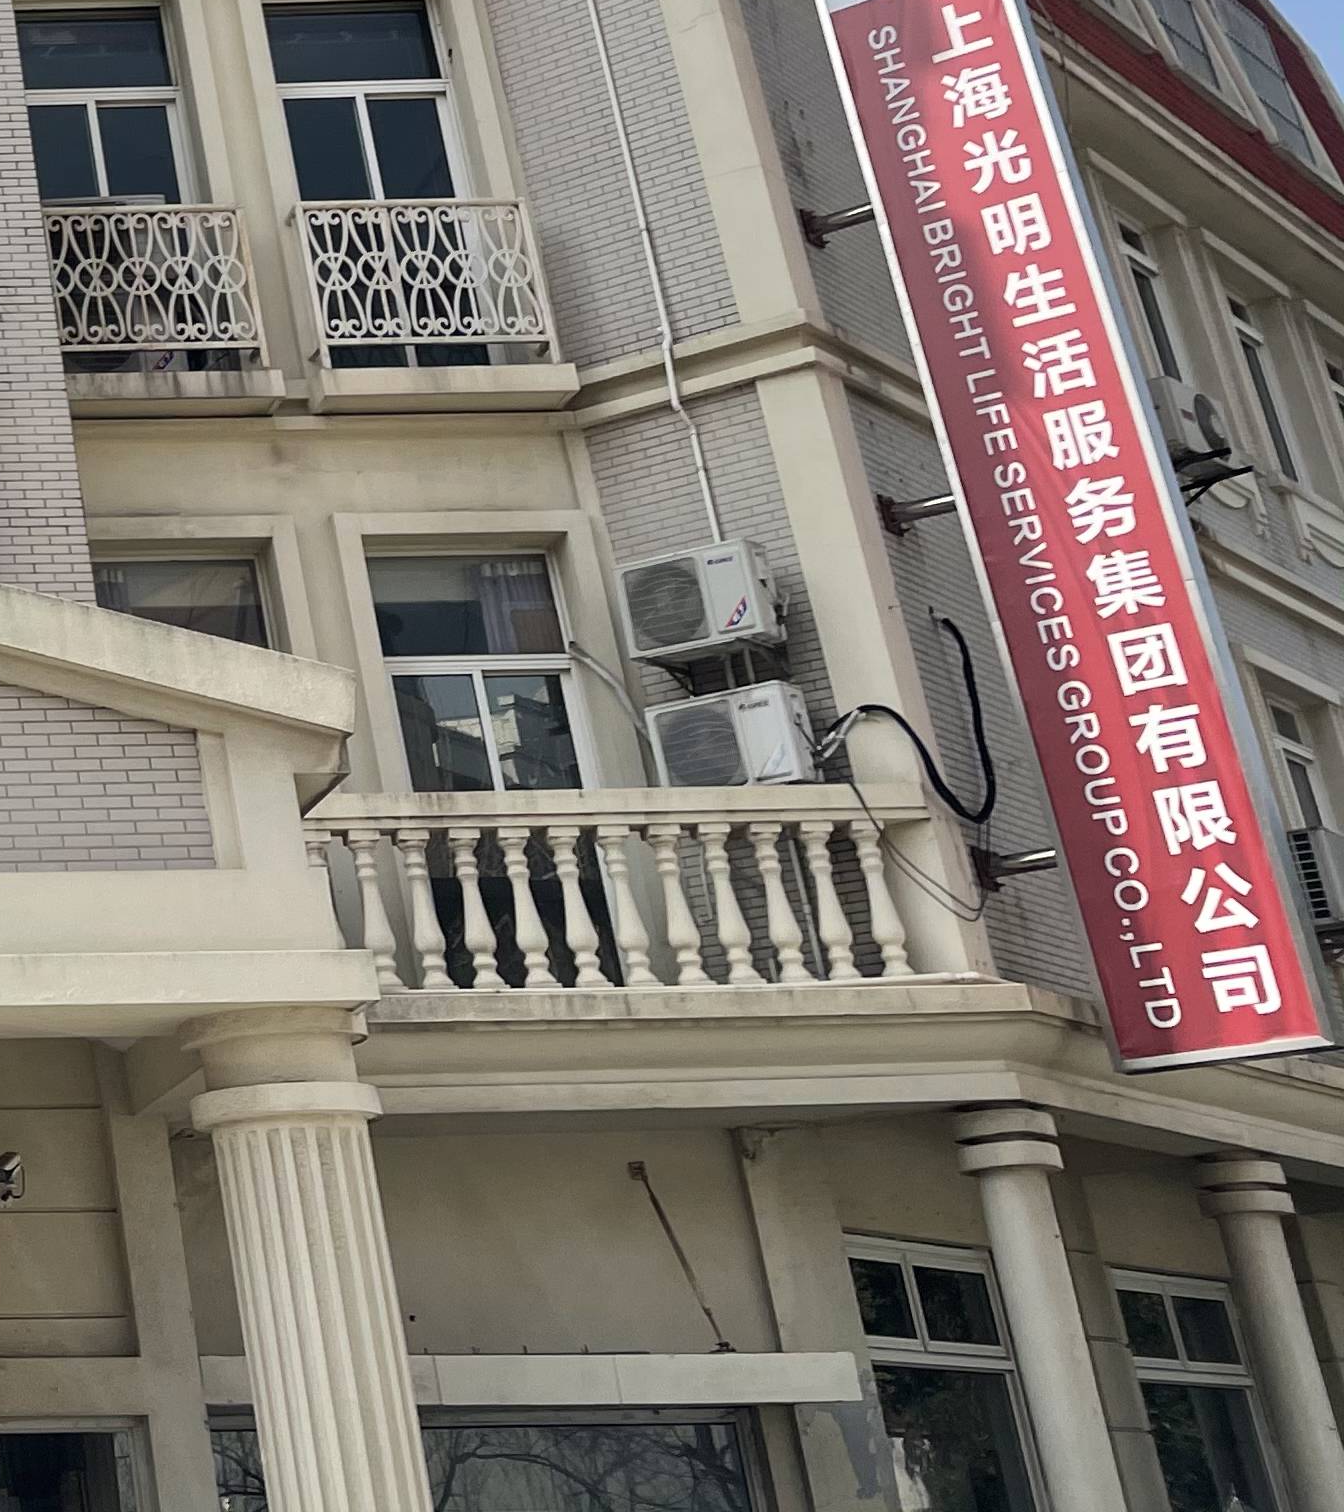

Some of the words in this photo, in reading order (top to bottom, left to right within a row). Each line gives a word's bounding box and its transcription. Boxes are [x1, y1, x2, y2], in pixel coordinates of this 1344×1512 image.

[867, 24, 947, 214] SHANGHAI
[922, 218, 991, 360] BRIGHT
[965, 368, 1018, 456] LIFE
[993, 462, 1081, 672] SERVICES
[1056, 679, 1129, 836] GROUP
[931, 3, 1282, 1015] 上海光明生活服务集团有限公司
